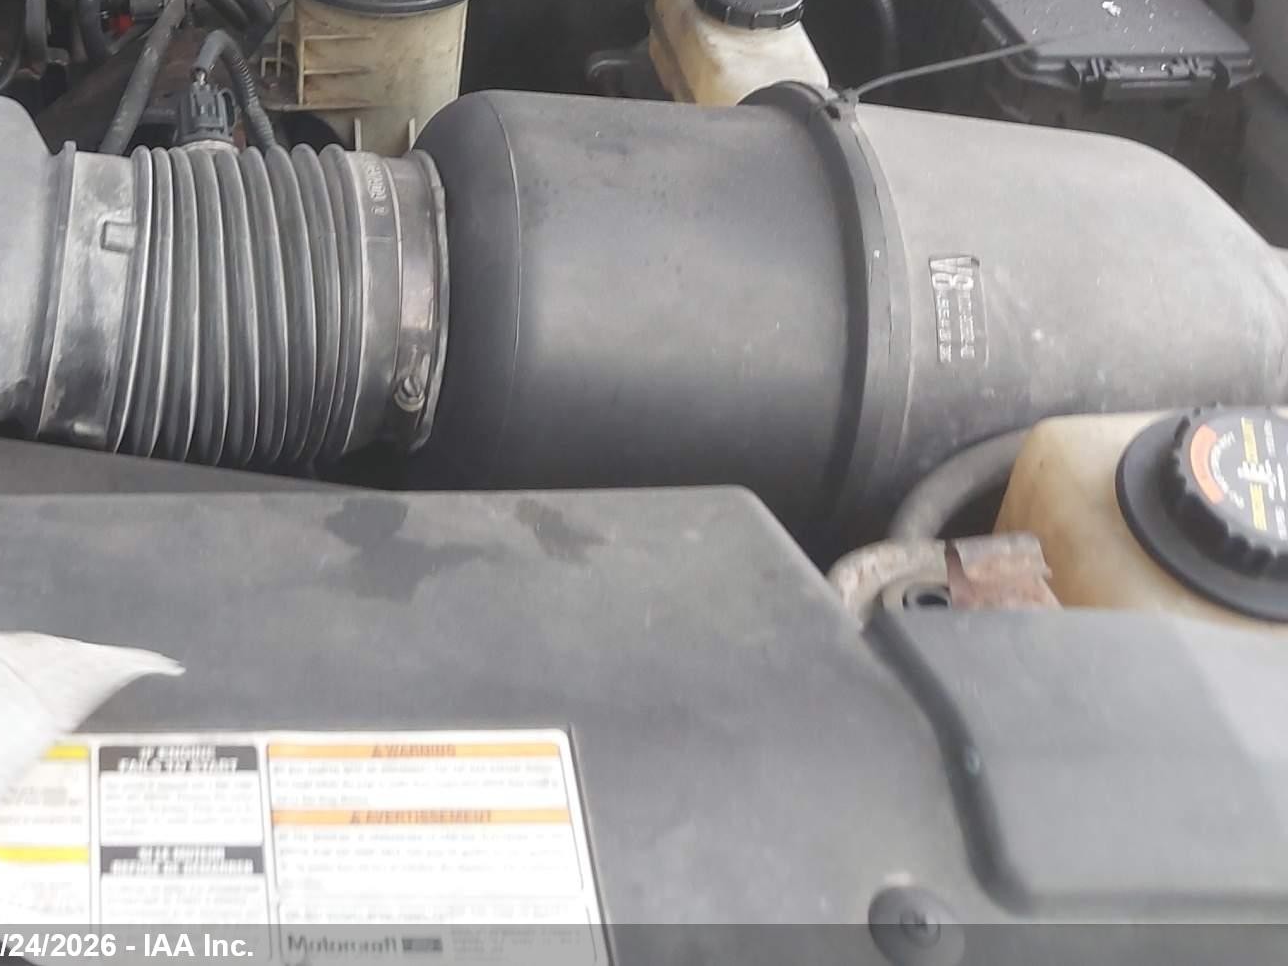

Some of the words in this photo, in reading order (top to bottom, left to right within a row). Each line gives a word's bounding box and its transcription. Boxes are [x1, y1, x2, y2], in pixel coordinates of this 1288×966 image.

[385, 745, 456, 758] WARNING
[366, 810, 491, 823] AVERTISSEMENT
[287, 934, 397, 954] Motorcraft
